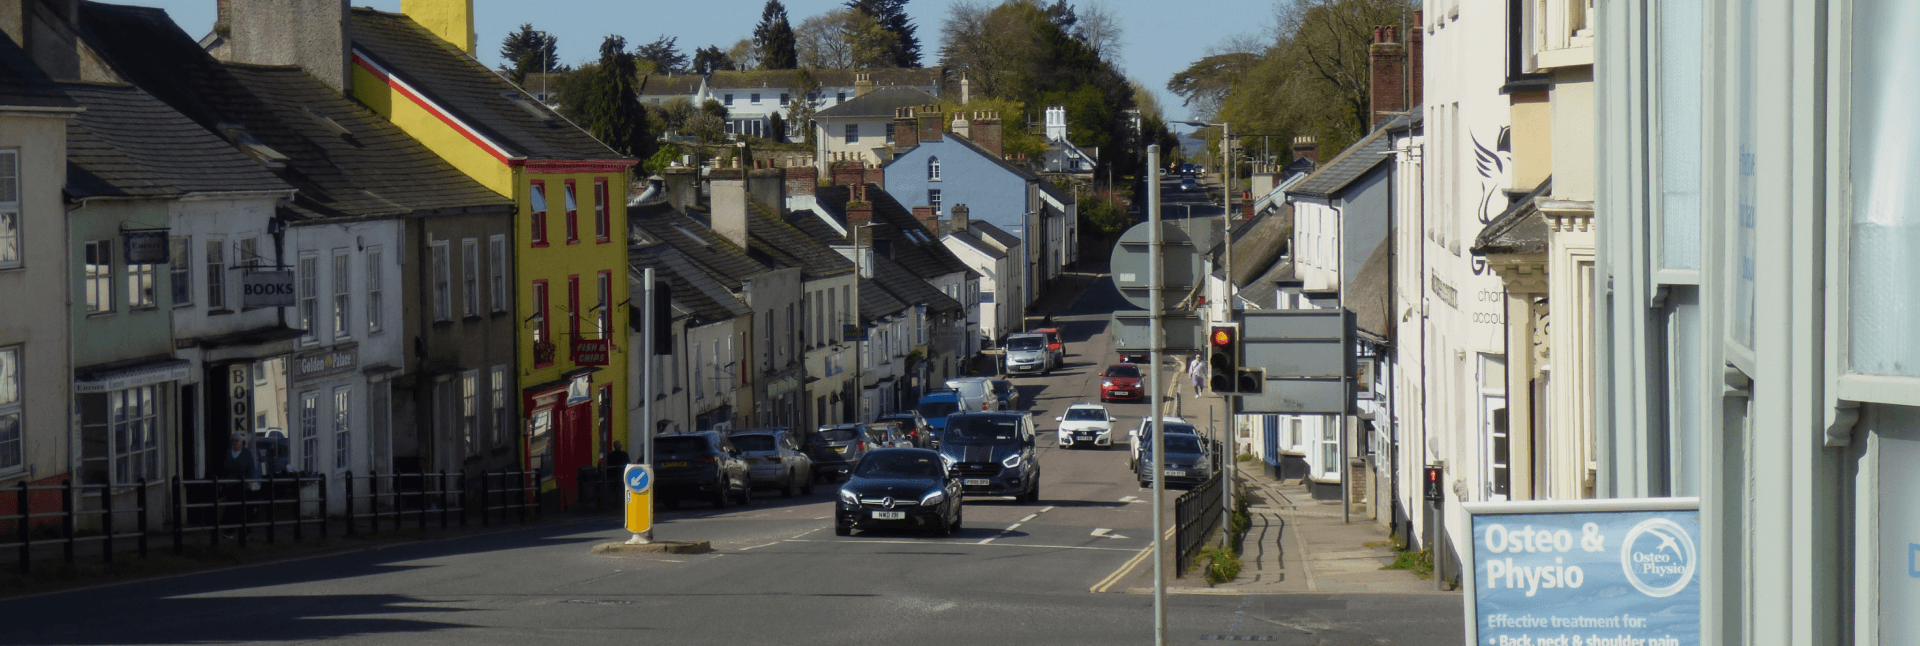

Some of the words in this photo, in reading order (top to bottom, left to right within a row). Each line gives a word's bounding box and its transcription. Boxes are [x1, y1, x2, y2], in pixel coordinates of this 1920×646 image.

[243, 283, 294, 295] BOOKS
[576, 343, 598, 352] FISH
[599, 344, 607, 352] &
[302, 356, 324, 374] Golden
[332, 352, 351, 368] Palace
[579, 353, 605, 363] CHIPS
[233, 369, 247, 437] BOOK
[1485, 523, 1573, 553] Osteo
[1580, 522, 1605, 552] &
[1633, 552, 1670, 563] Osteo
[1487, 556, 1584, 597] Physio
[1634, 563, 1643, 574] &
[1643, 562, 1685, 577] Physio
[1488, 614, 1548, 628] Effective
[1551, 615, 1620, 628] treatment
[1622, 614, 1647, 628] for:
[1537, 634, 1570, 646] neck
[1572, 635, 1583, 646] &
[1586, 634, 1646, 646] shoulder
[1648, 635, 1679, 646] pain
